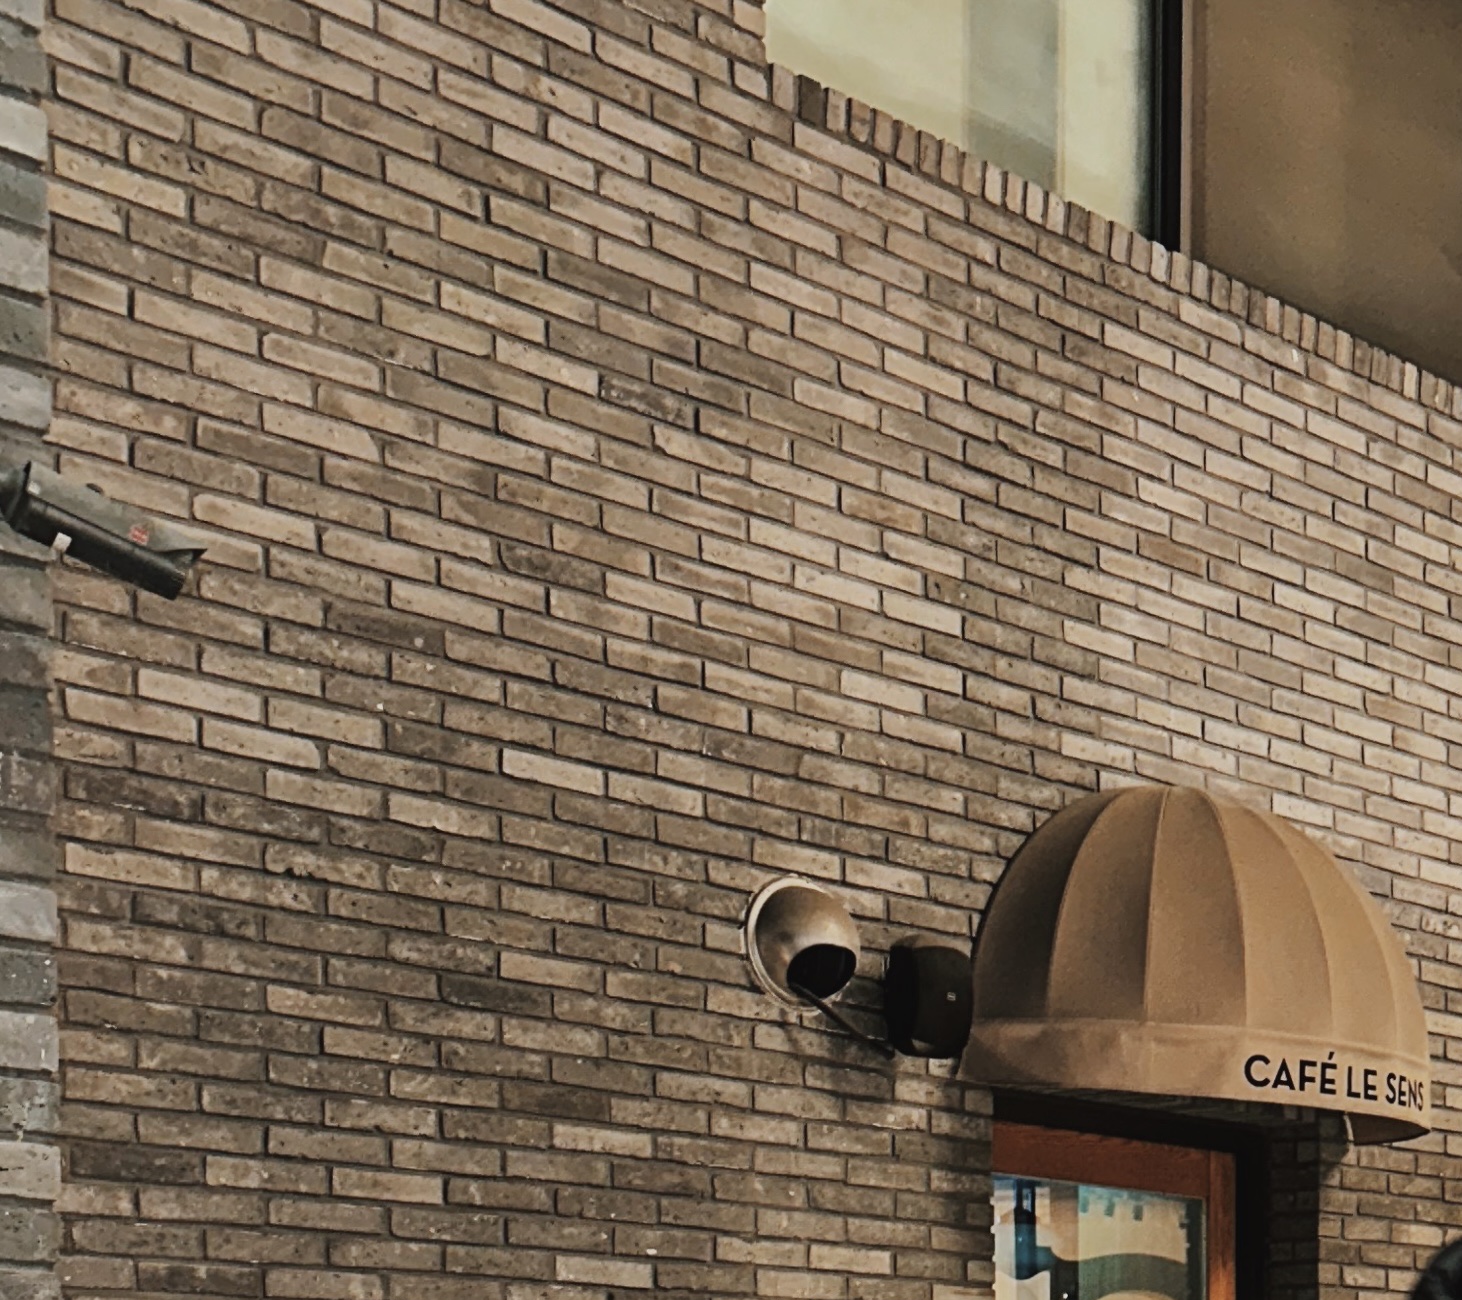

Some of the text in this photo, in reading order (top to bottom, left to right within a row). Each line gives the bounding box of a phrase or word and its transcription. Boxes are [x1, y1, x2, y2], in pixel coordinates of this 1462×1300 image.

[1244, 1052, 1424, 1112] CAFÉ LE SENS
